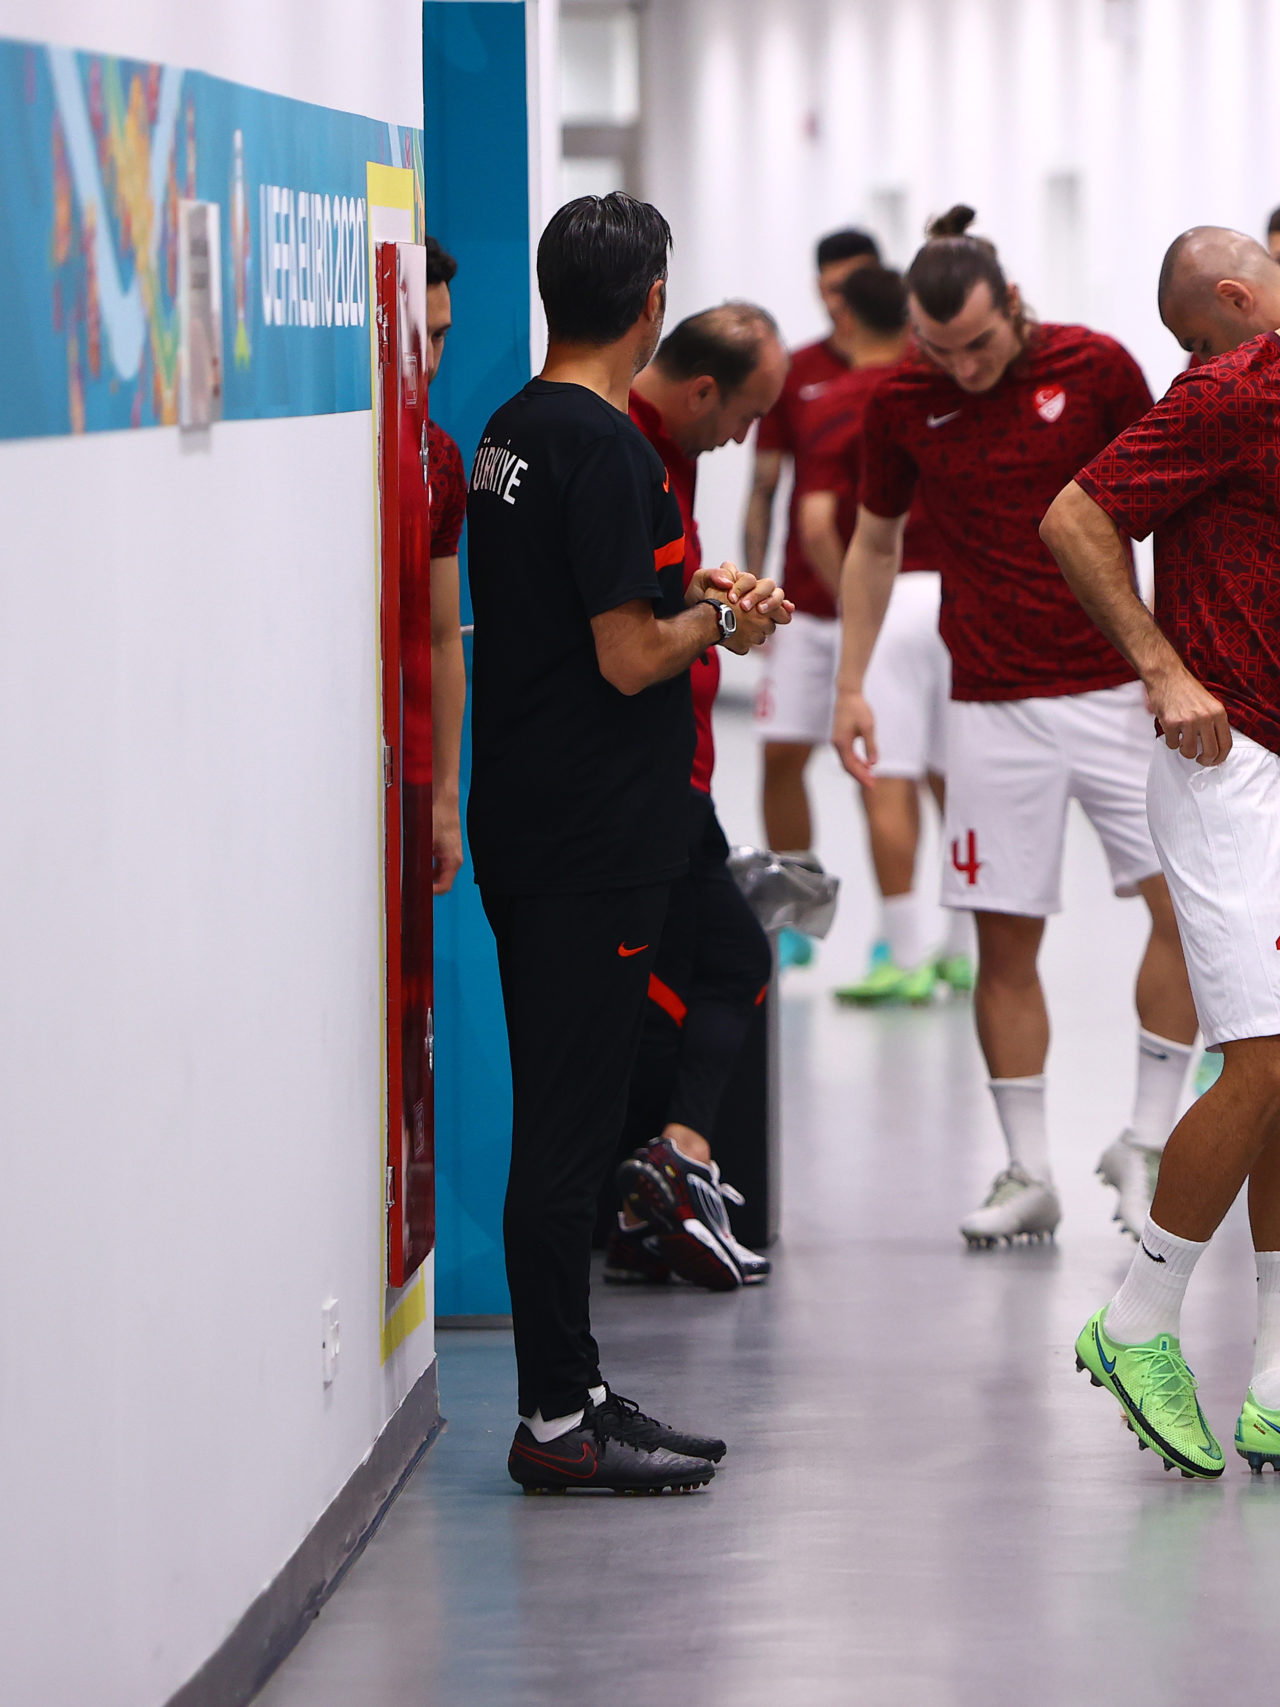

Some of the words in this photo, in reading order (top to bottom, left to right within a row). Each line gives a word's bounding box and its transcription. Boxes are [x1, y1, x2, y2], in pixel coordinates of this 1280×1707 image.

[259, 183, 299, 326] UEFA
[297, 190, 333, 328] EURO
[333, 194, 366, 328] 2020
[951, 829, 983, 886] 4
